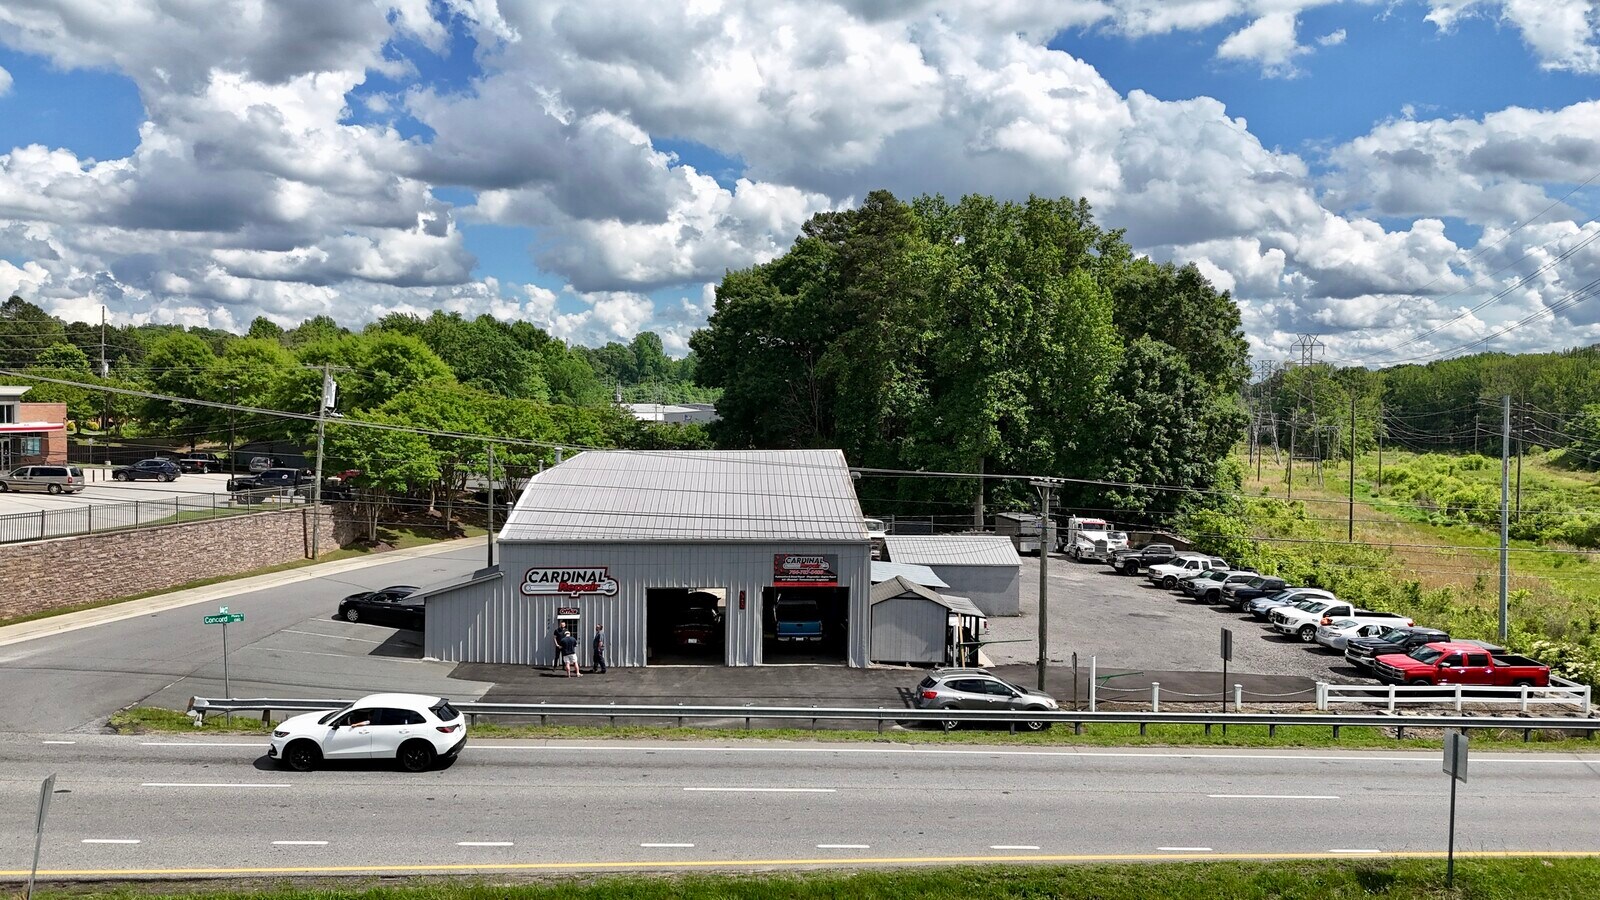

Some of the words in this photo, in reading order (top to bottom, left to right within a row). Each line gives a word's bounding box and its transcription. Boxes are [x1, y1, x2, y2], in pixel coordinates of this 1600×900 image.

[528, 570, 606, 583] CARDINAL
[558, 581, 600, 594] Repair
[204, 616, 228, 624] Concord
